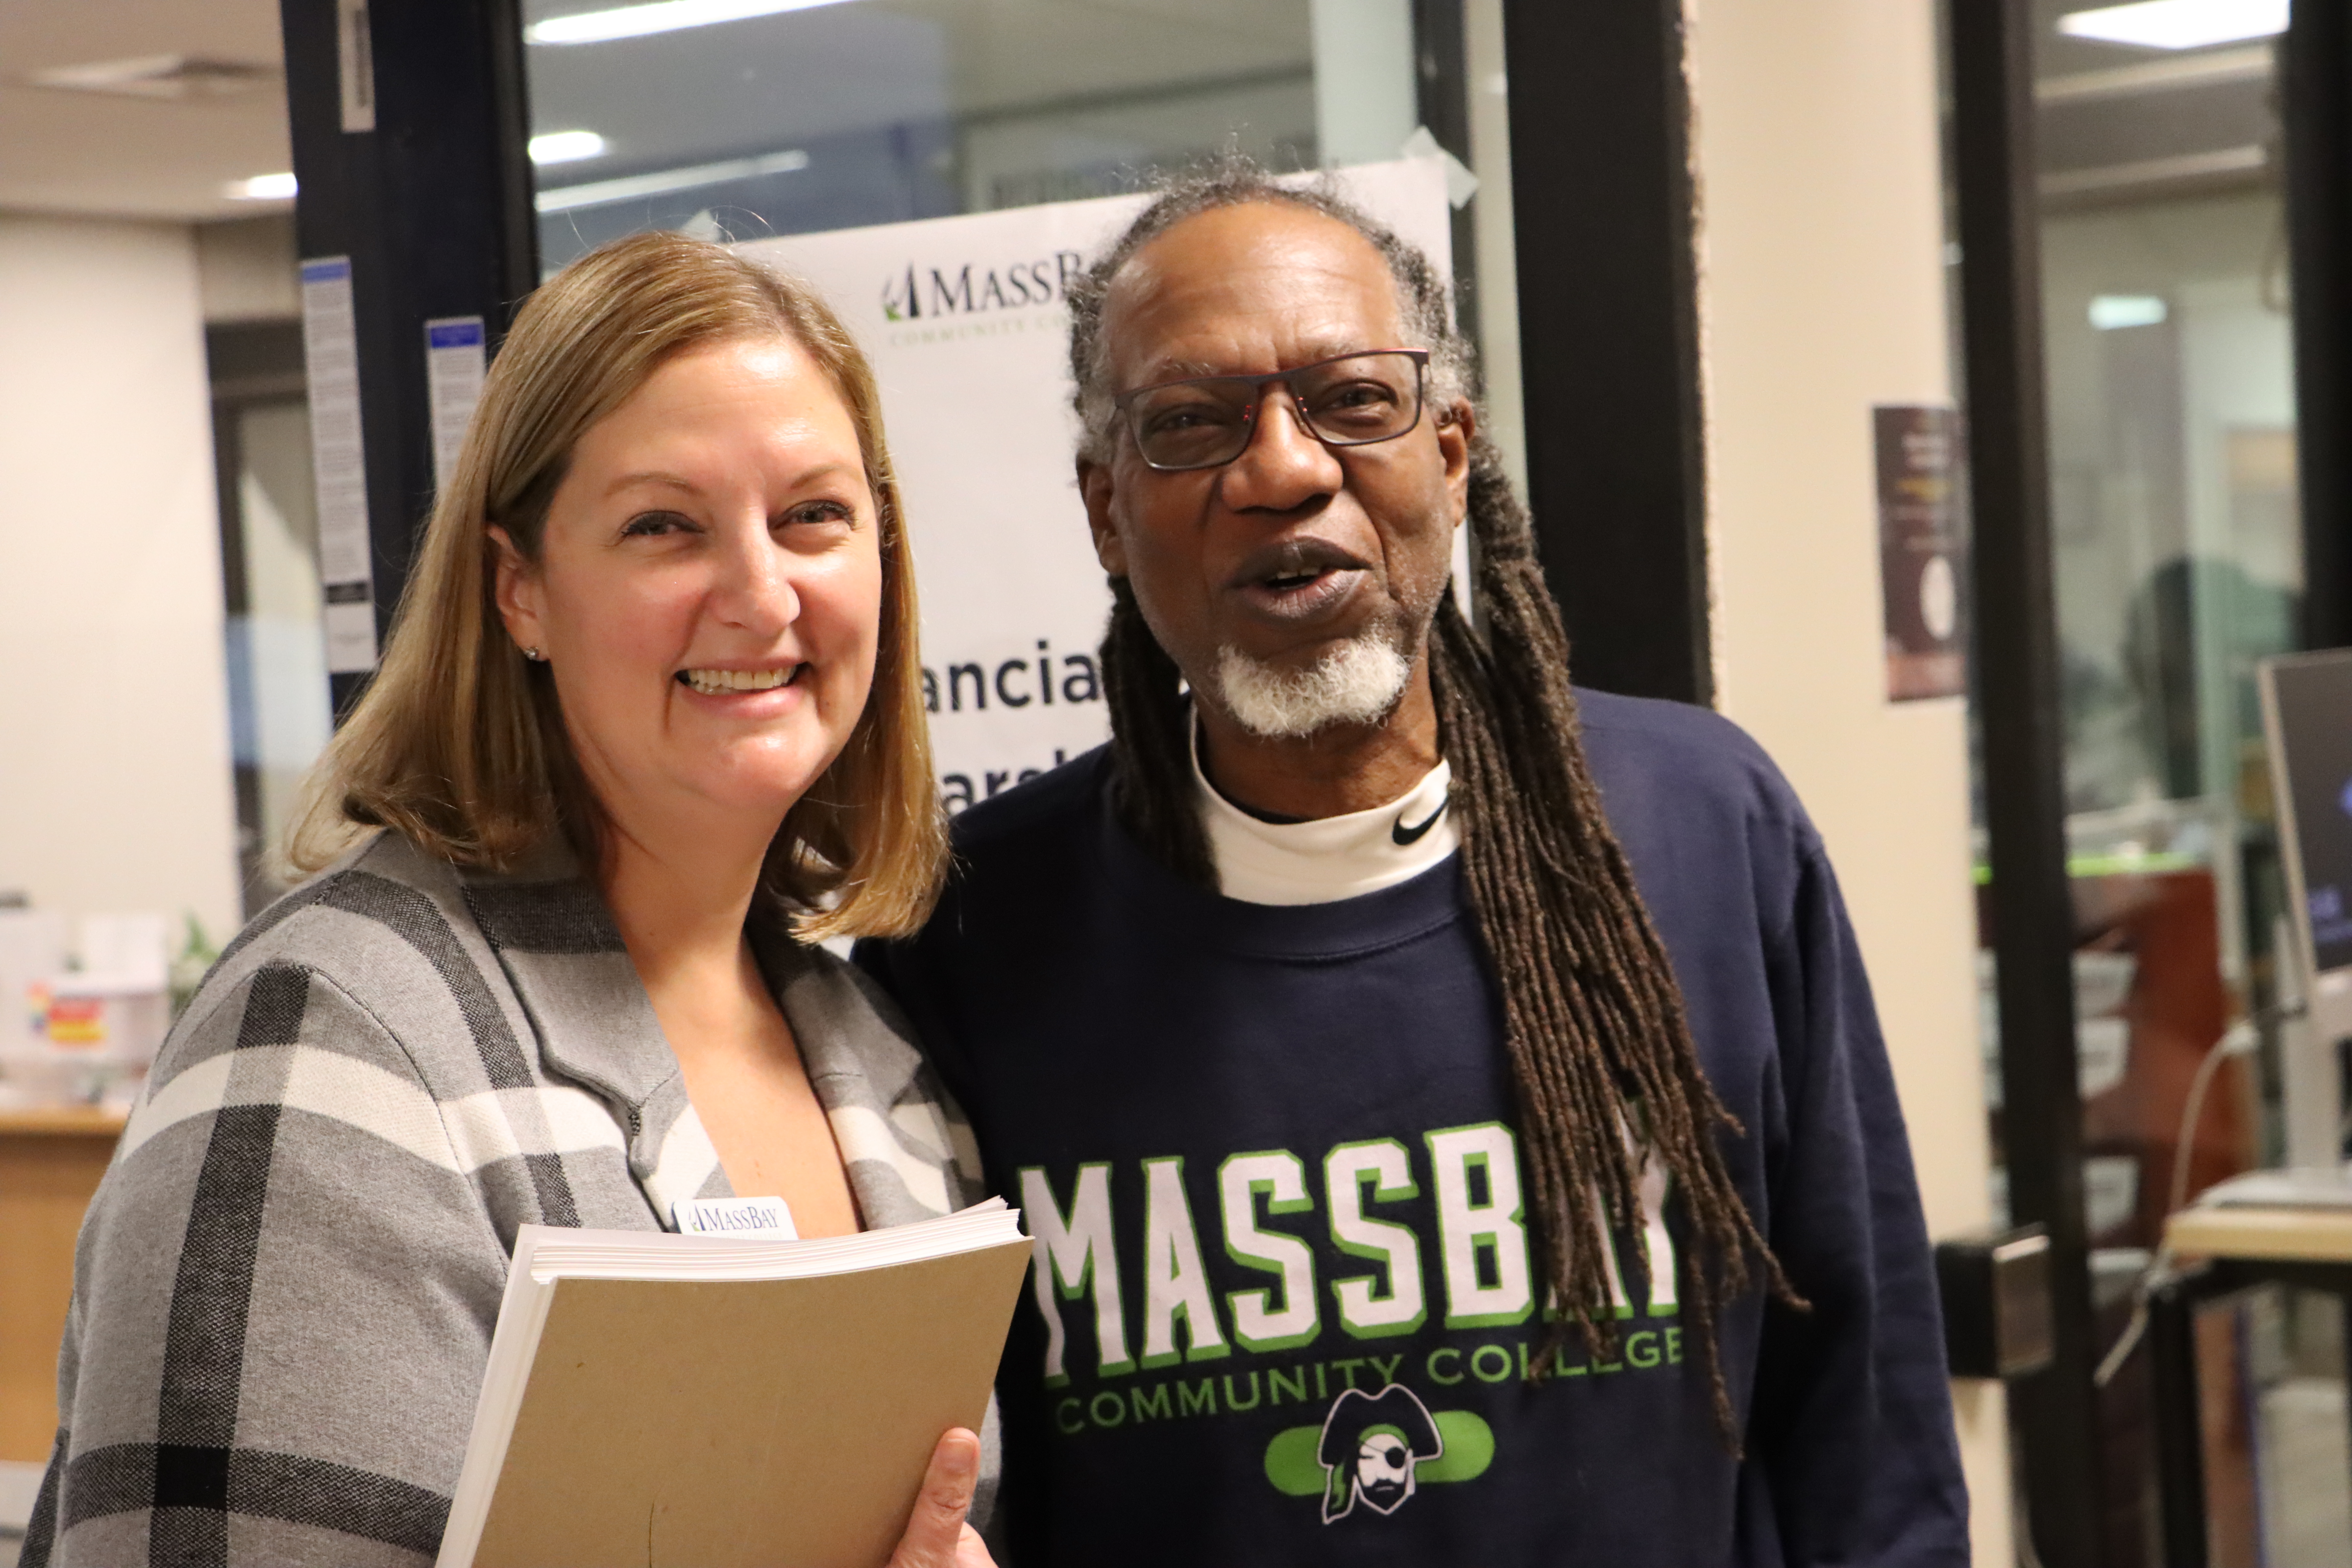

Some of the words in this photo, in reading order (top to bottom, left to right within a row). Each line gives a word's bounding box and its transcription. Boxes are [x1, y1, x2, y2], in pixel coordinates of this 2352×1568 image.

[889, 318, 1025, 346] COMMUNITY
[1056, 1353, 1404, 1434] COMMUNITY
[1426, 1326, 1683, 1385] COLLGE
